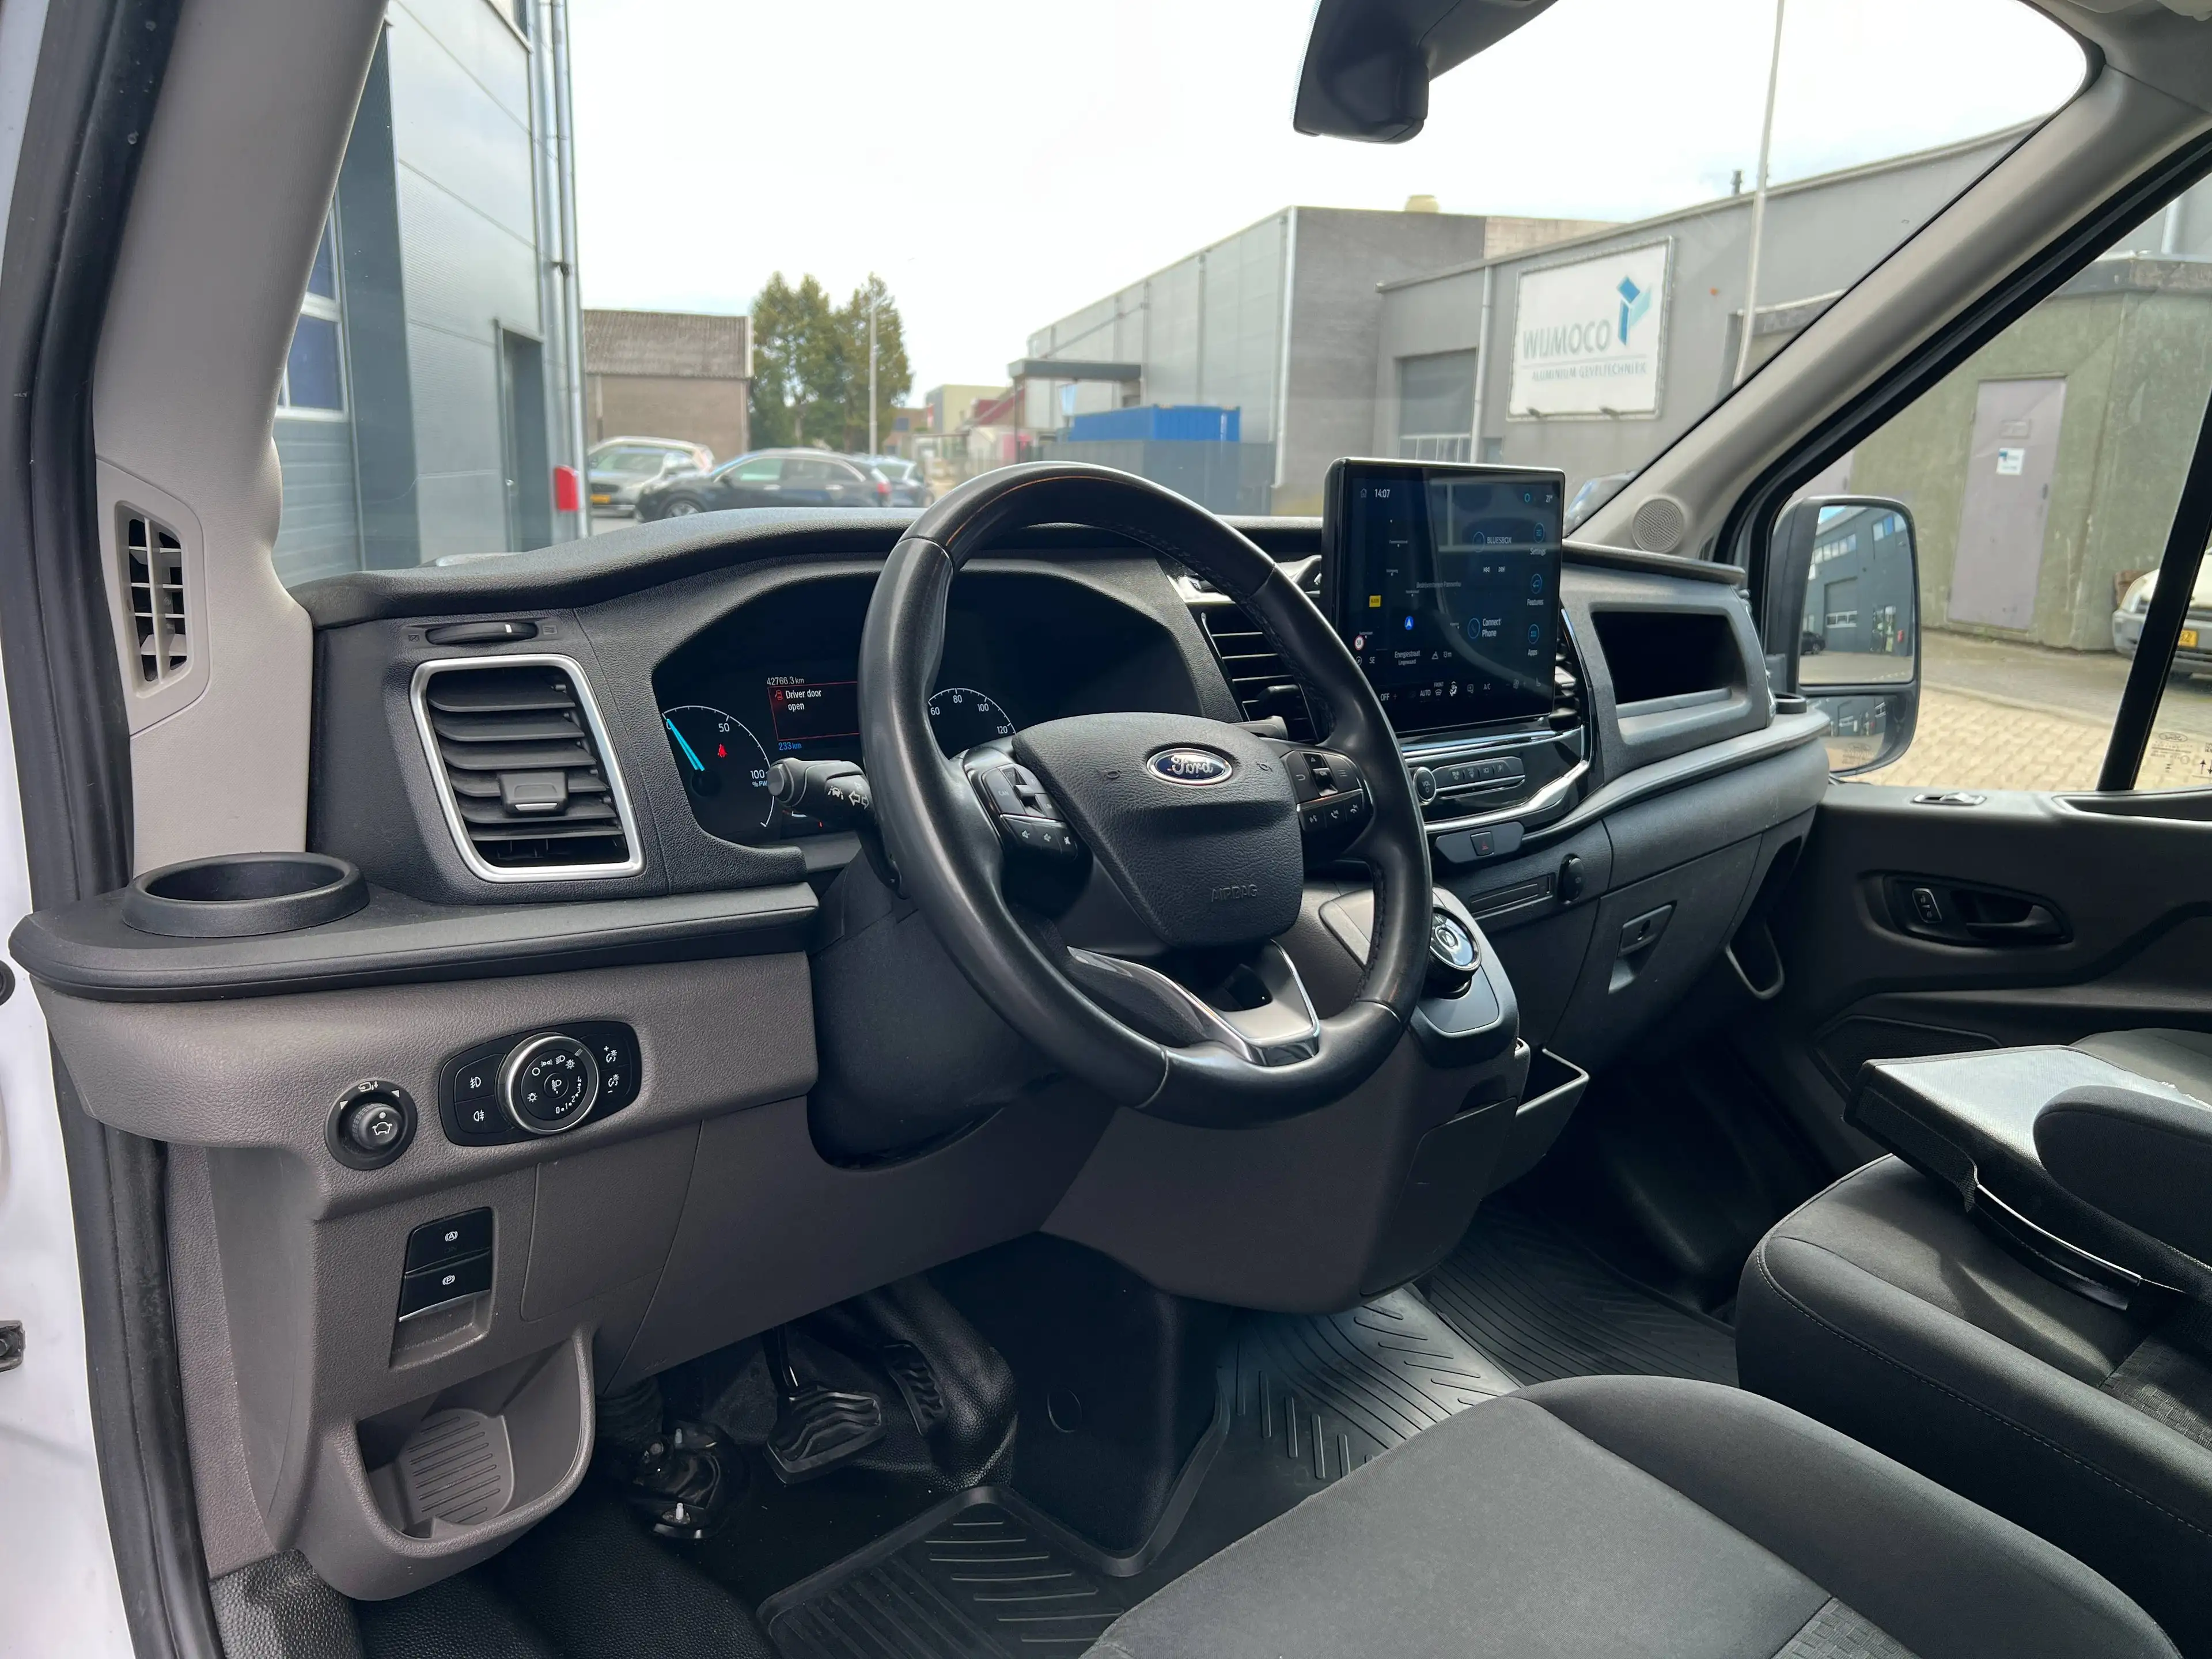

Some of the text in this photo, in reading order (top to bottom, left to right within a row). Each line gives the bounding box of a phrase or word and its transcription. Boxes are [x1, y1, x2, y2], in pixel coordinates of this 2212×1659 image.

[1532, 366, 1577, 381] ALUMINIUM
[1374, 488, 1391, 498] 14:07
[1487, 536, 1512, 544] BLUESBOX
[1530, 548, 1546, 556] Settings
[1482, 618, 1502, 627] Connect
[1482, 630, 1497, 638] Phone
[1527, 649, 1538, 657] Apps
[767, 676, 795, 686] 42766.3
[785, 689, 822, 699] Driver door
[1380, 693, 1390, 701] OFF
[1419, 689, 1431, 697] AUTO
[952, 695, 963, 703] 80
[787, 703, 805, 713] open
[930, 707, 940, 715] 60
[977, 703, 990, 712] 100
[718, 722, 730, 733] 50
[997, 726, 1008, 734] 120
[778, 742, 792, 751] 233
[1169, 755, 1214, 775] Ford
[750, 770, 765, 779] 100
[1211, 884, 1258, 903] AIRBAG
[555, 1106, 560, 1114] 0
